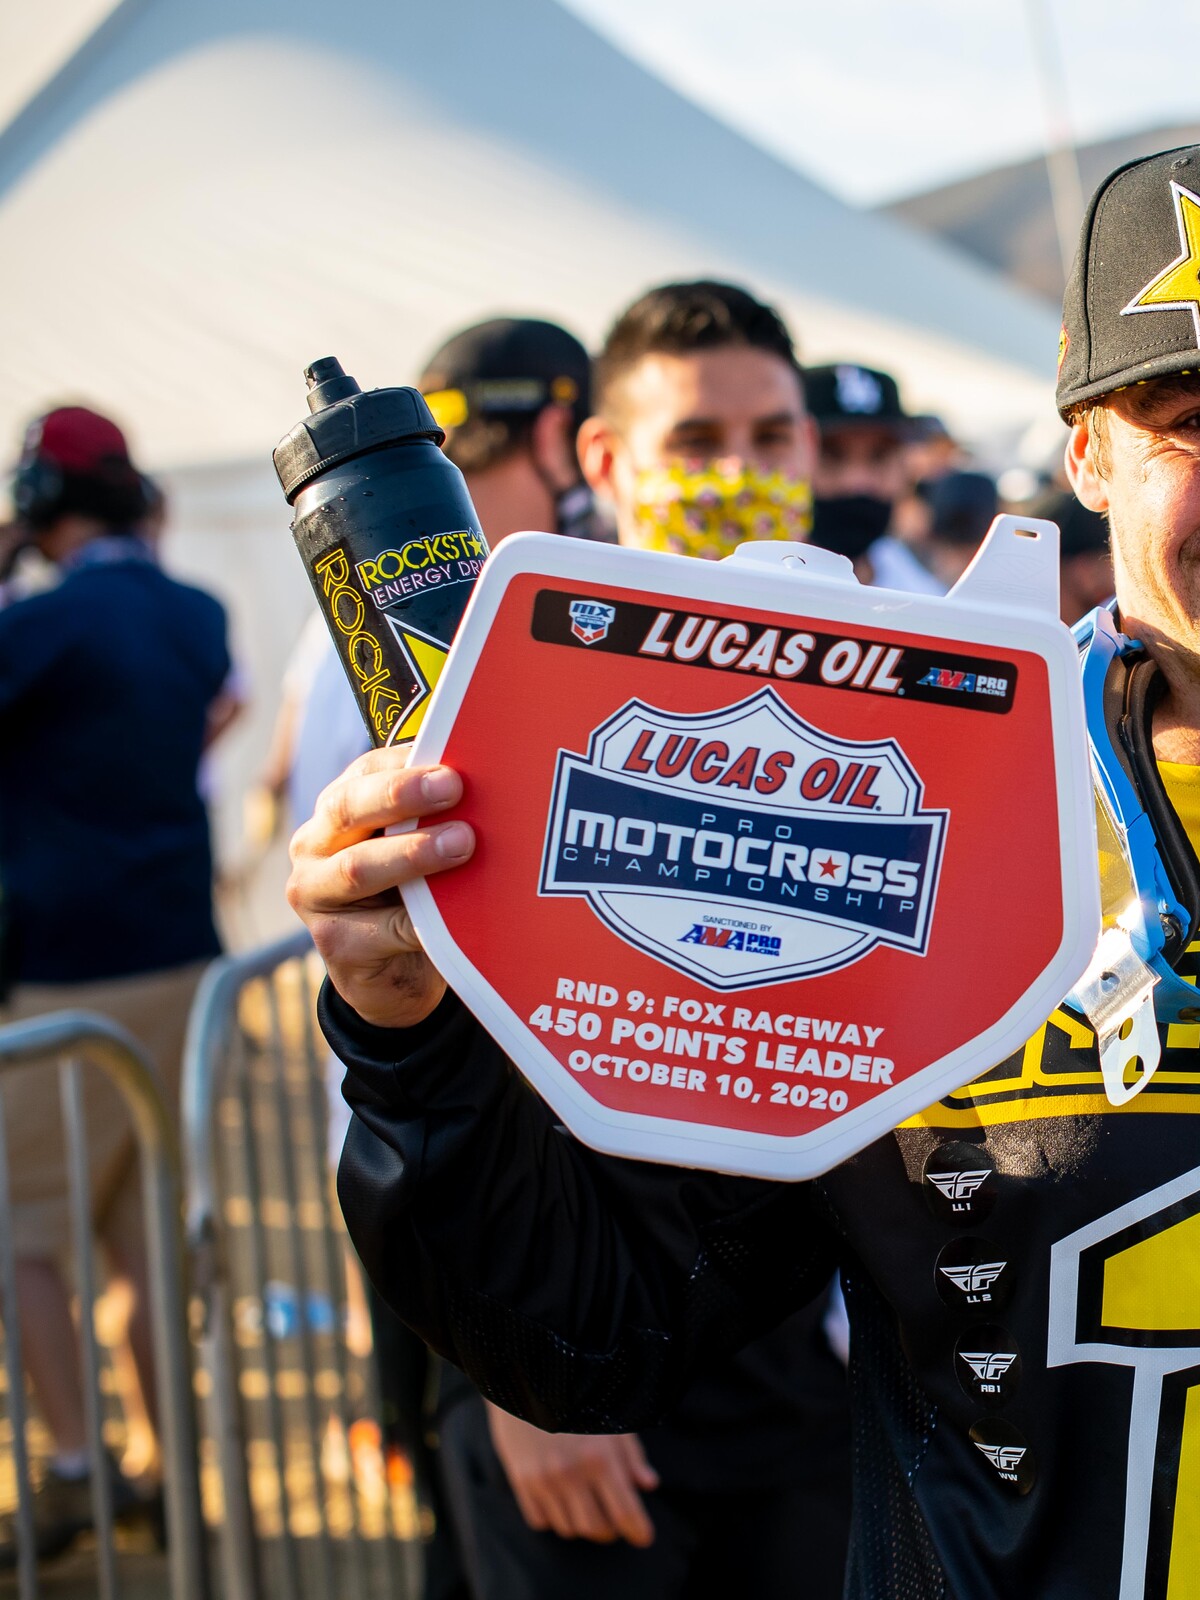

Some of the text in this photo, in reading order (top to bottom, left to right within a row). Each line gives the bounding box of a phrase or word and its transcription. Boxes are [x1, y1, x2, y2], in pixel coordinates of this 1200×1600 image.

[374, 559, 485, 605] ENERGY DRI
[572, 602, 613, 618] MX
[639, 612, 903, 694] LUCAS OIL
[916, 667, 976, 692] AMA
[975, 686, 1006, 697] RACING
[976, 675, 1008, 691] PRO
[622, 729, 795, 796] LUCAS
[701, 812, 793, 839] PRO
[564, 808, 921, 897] MOTOCROSS
[562, 846, 915, 913] CHAMPIONSHIP
[702, 914, 773, 932] SANCTIONED BY
[676, 923, 746, 952] AMA
[747, 933, 782, 949] PRO
[745, 945, 780, 957] RACING
[556, 977, 885, 1049] RND 9: FOX RACEWAY
[529, 1004, 895, 1086] 450 POINTS LEADER
[568, 1049, 849, 1113] OCTOBER 10, 2020
[952, 1203, 965, 1211] LL
[966, 1293, 992, 1303] LL 2
[980, 1384, 996, 1393] RB
